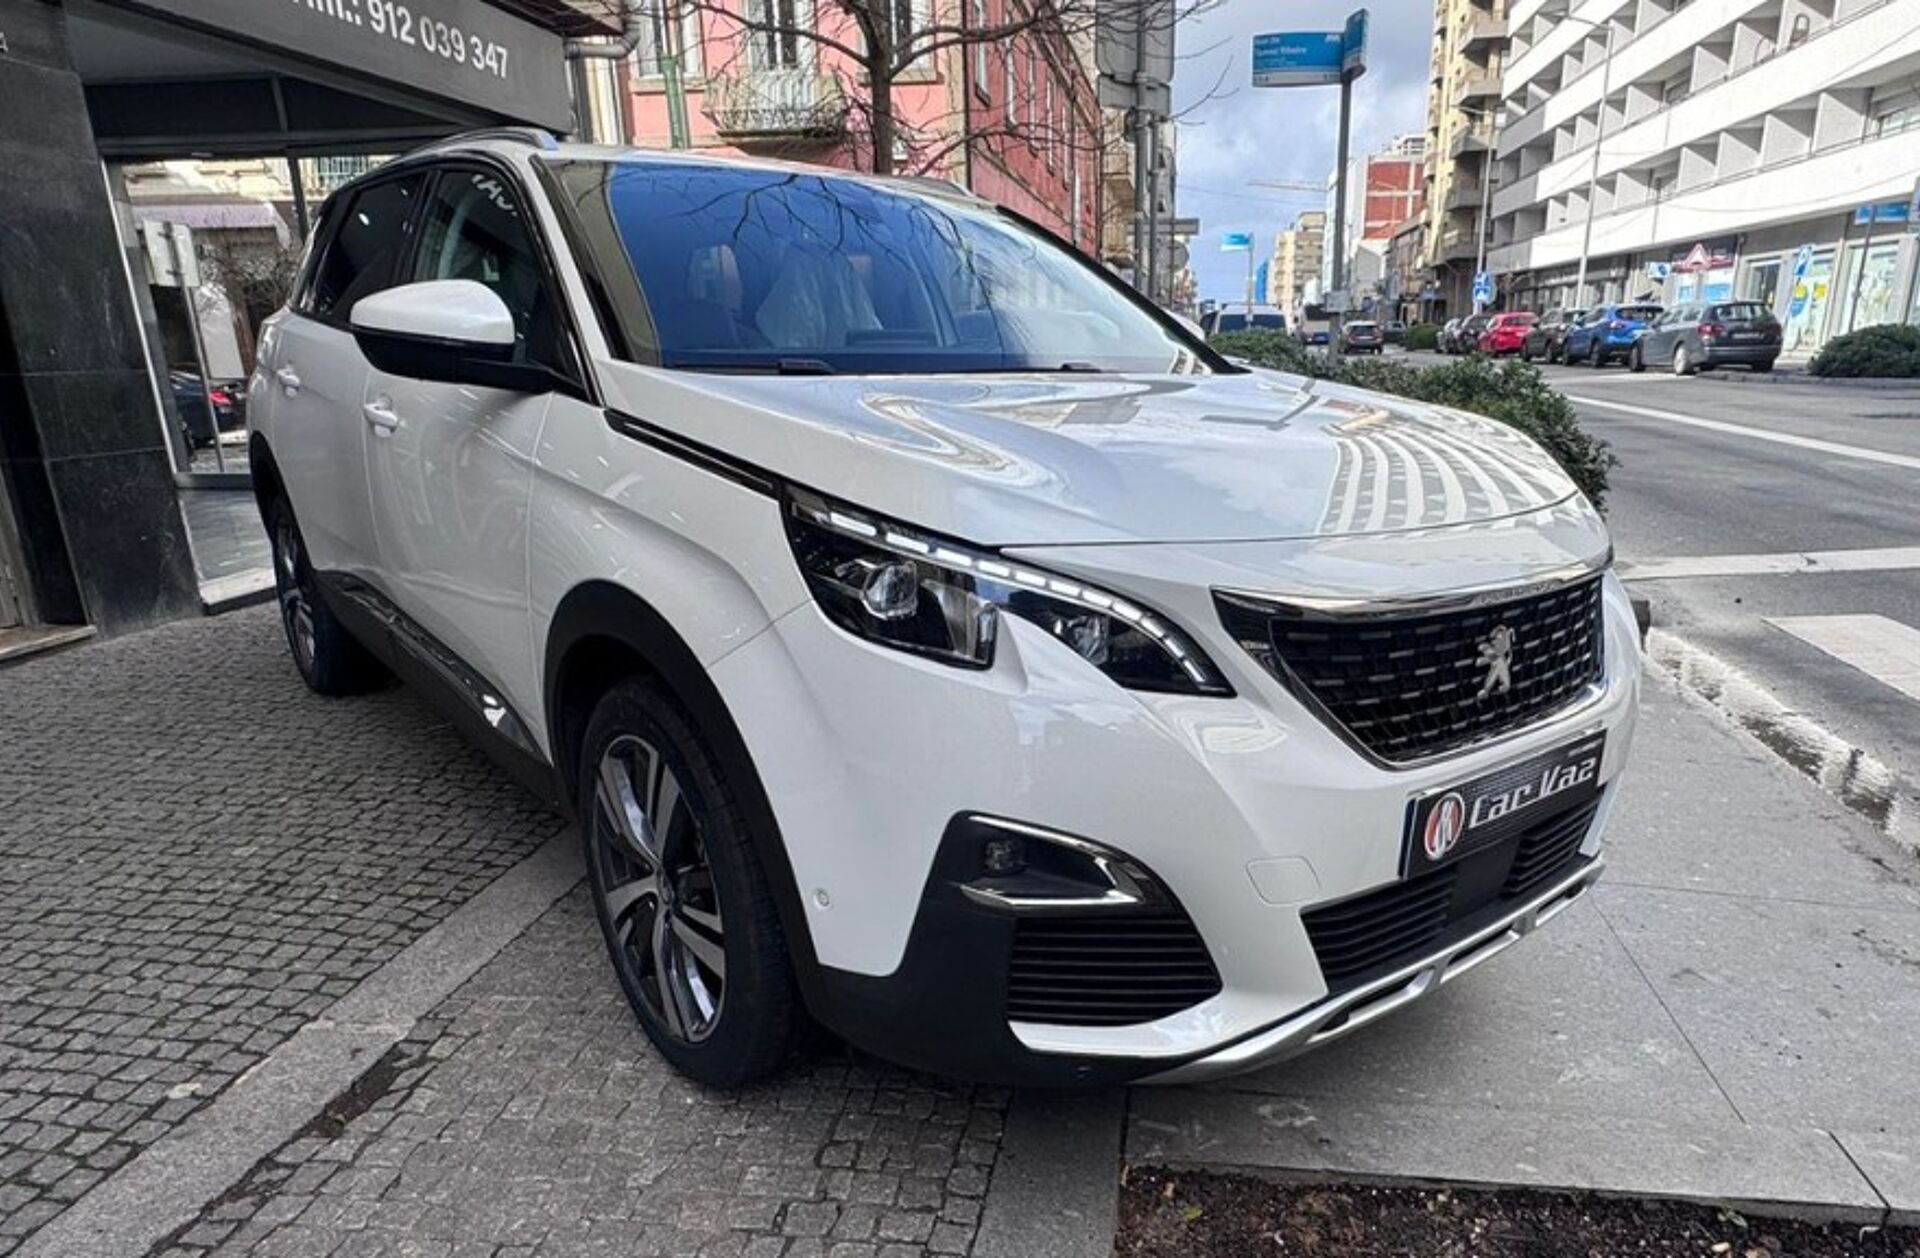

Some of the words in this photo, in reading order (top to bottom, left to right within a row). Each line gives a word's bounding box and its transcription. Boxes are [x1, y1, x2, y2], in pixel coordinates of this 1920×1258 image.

[368, 0, 415, 45] 912
[420, 16, 464, 63] 039
[470, 35, 507, 78] 347
[1469, 784, 1532, 829] Car
